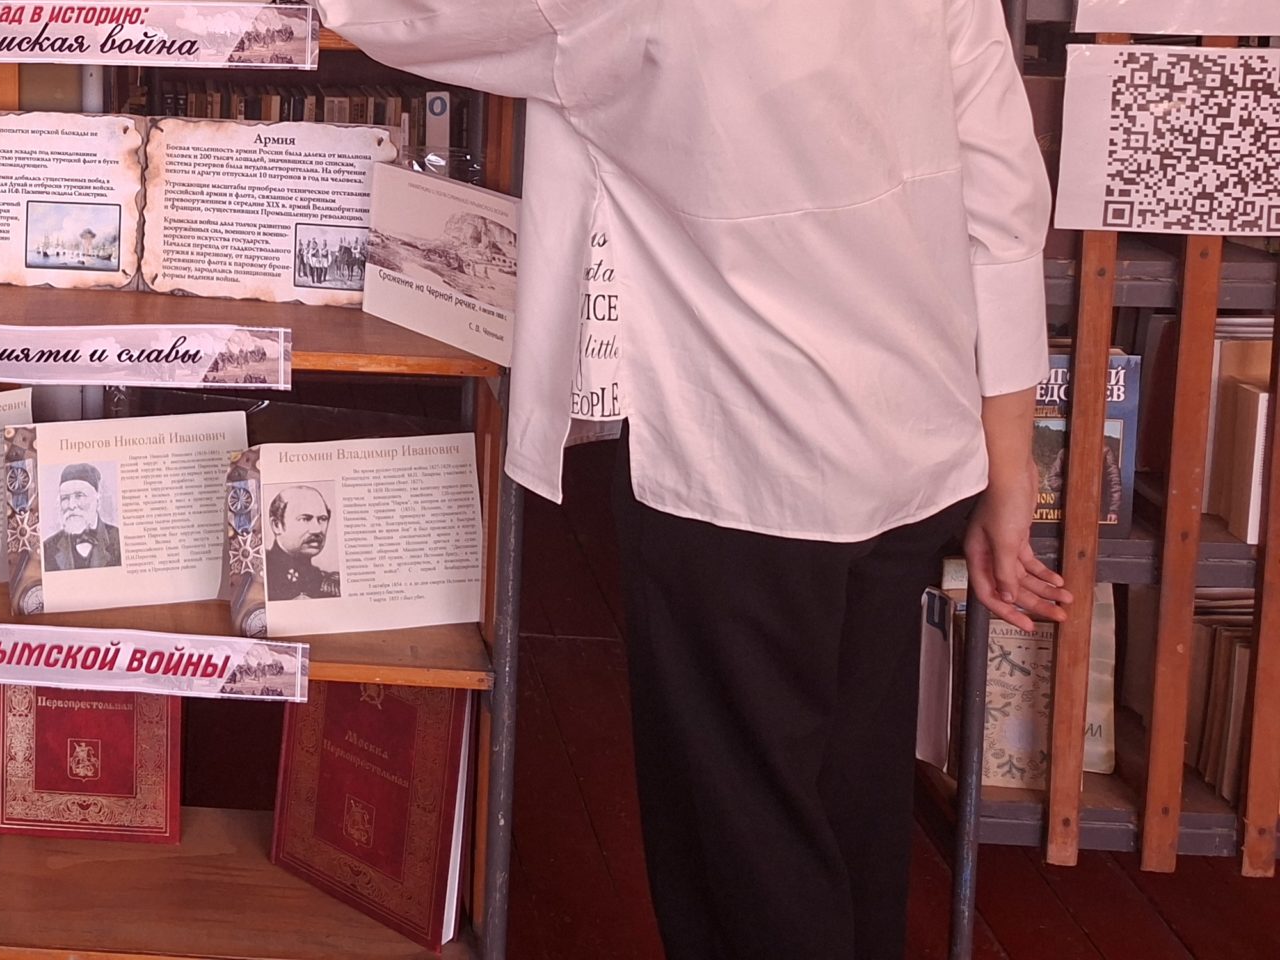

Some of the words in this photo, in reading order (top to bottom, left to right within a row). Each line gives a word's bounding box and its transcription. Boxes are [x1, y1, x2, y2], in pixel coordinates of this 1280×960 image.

[29, 8, 42, 24] в
[47, 5, 150, 26] историю:
[99, 22, 200, 56] война
[191, 146, 233, 154] численность
[253, 133, 296, 146] Армия
[379, 269, 414, 289] Сражение
[416, 282, 424, 292] на
[426, 285, 452, 302] Черной
[455, 297, 478, 312] речке.
[88, 347, 108, 362] и
[116, 335, 202, 365] славы
[571, 382, 620, 417] EOPLE
[60, 438, 112, 453] Пирогов
[114, 432, 166, 447] Николай
[169, 432, 226, 444] Иванович
[279, 449, 333, 464] Истомин
[337, 446, 398, 462] Владимир
[402, 444, 460, 457] Иванович
[126, 646, 231, 679] войны
[36, 696, 134, 712] Первопрестольная
[345, 730, 389, 759] Москва
[323, 739, 409, 788] Первопрестольная
